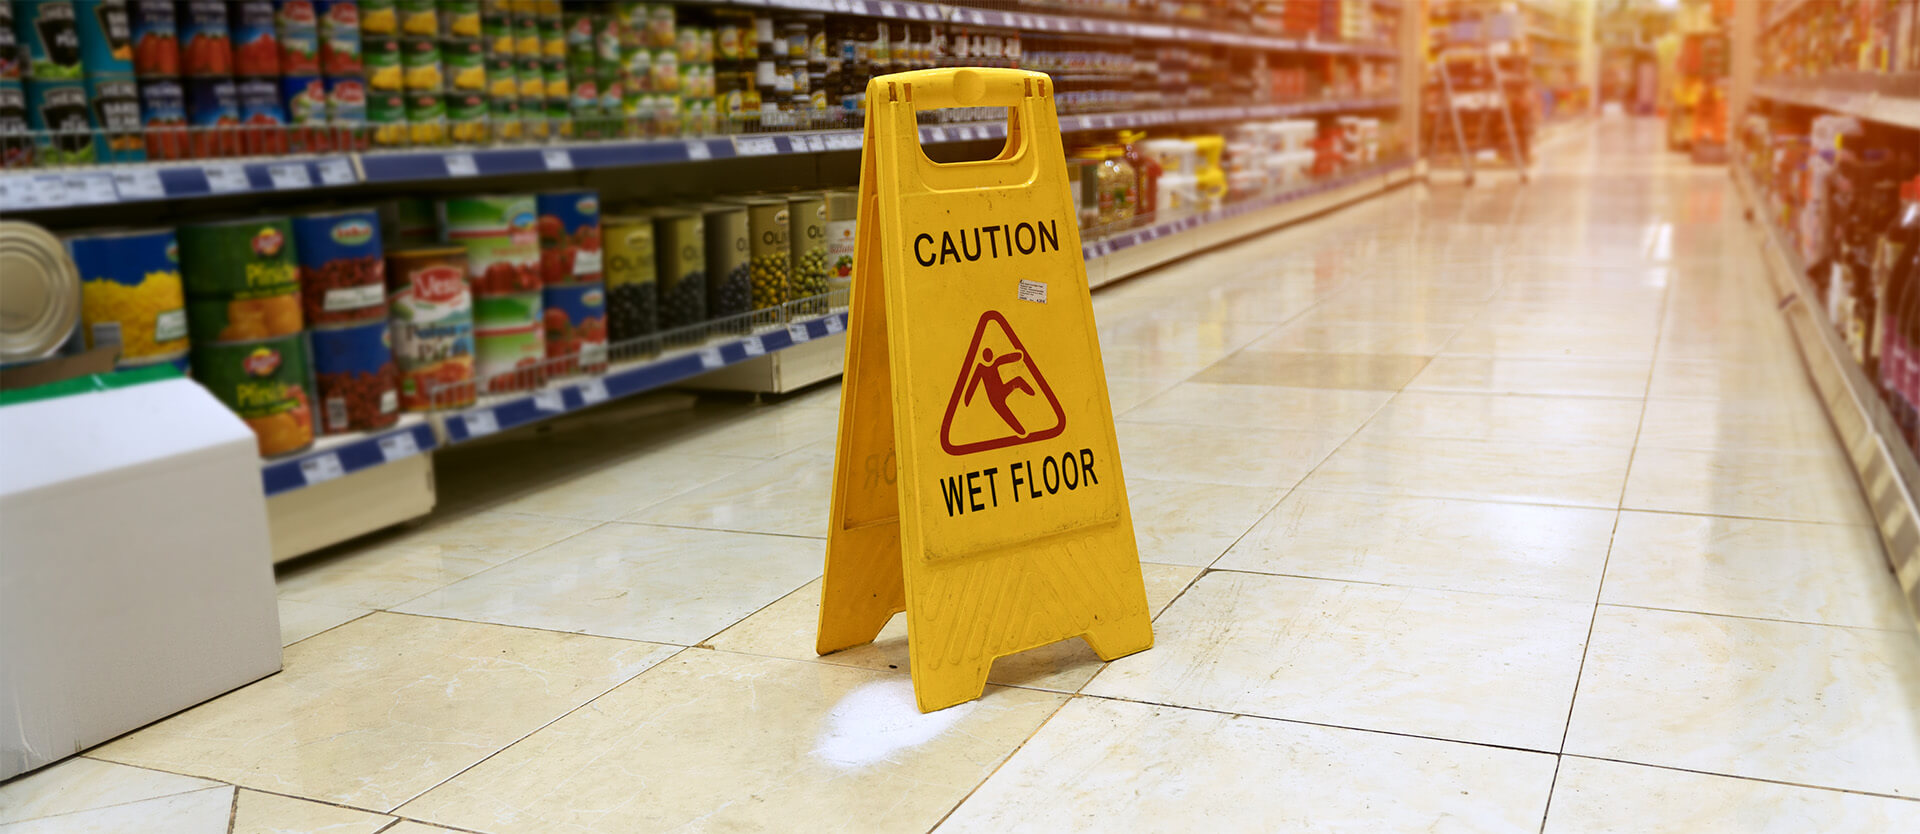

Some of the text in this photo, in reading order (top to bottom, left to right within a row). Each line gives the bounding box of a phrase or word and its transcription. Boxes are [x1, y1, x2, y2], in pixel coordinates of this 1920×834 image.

[914, 220, 1058, 266] CAUTION
[940, 449, 1098, 516] WET FLOOR
